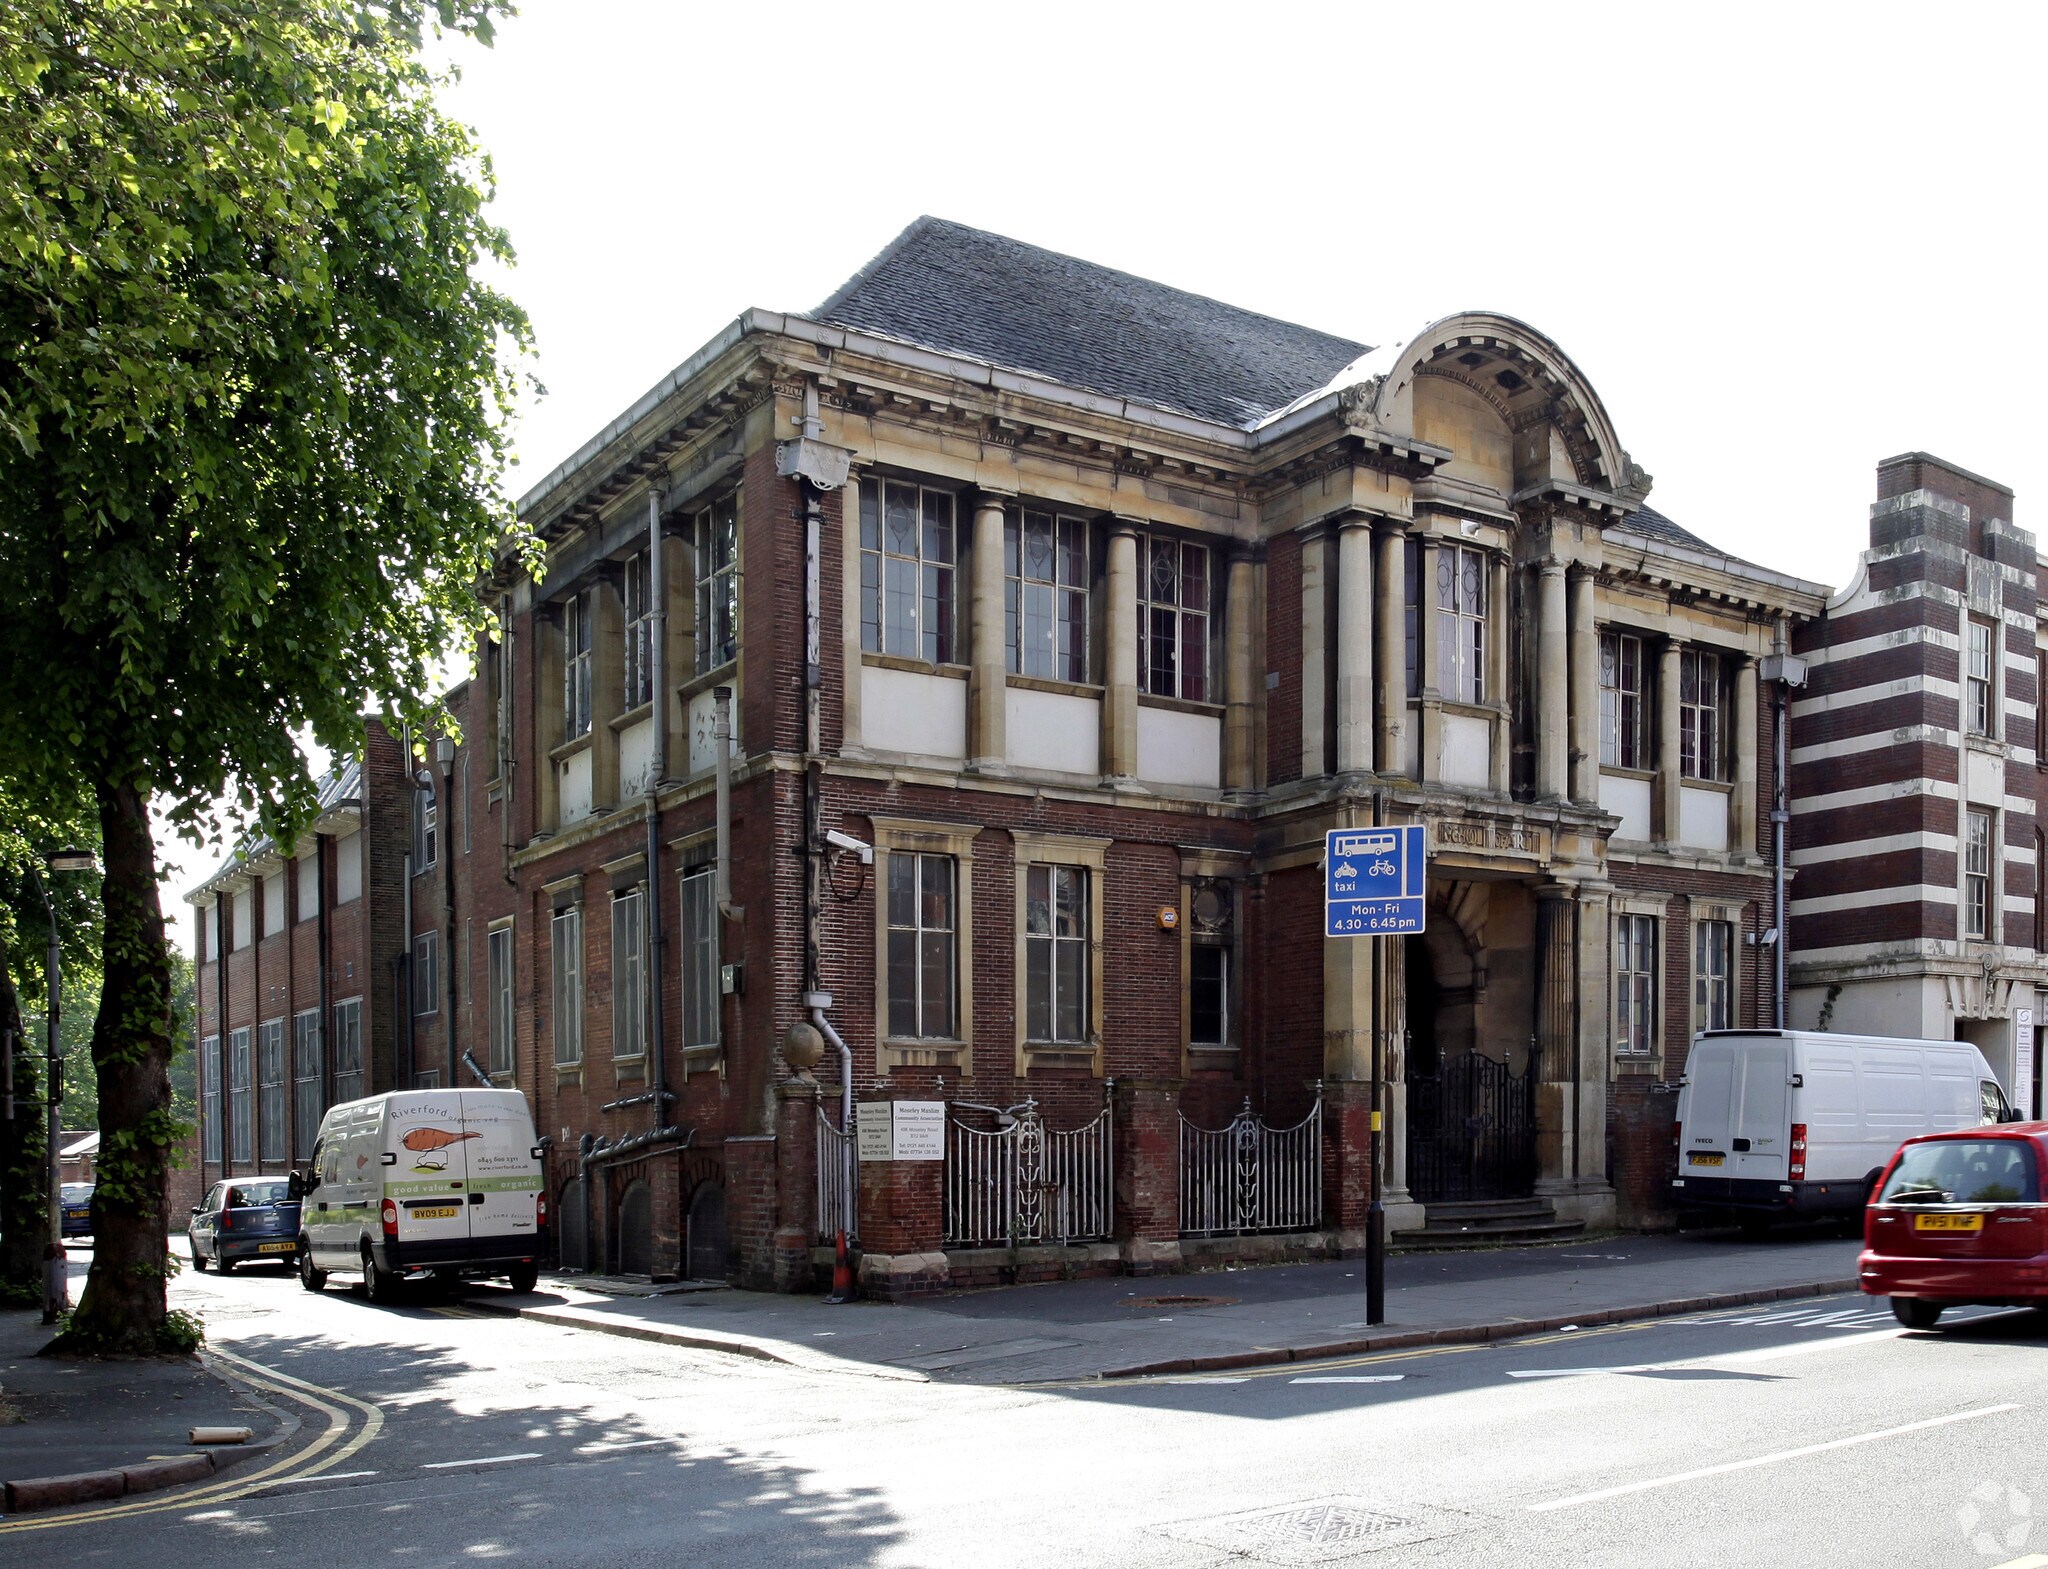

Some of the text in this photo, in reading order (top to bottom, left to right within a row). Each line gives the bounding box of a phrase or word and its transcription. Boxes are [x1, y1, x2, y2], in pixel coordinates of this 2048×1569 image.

[1334, 881, 1356, 892] taxi
[1351, 905, 1376, 915] Mon
[1385, 903, 1400, 914] Fri
[1334, 919, 1362, 930] 4.30
[1370, 917, 1397, 929] 6.45
[1398, 919, 1416, 929] pm
[390, 1104, 448, 1120] Riverford
[899, 1107, 920, 1115] Moseley
[477, 1156, 493, 1164] 0845
[393, 1183, 450, 1196] good value
[500, 1178, 537, 1190] organic
[414, 1208, 456, 1219] BV09 EJJ
